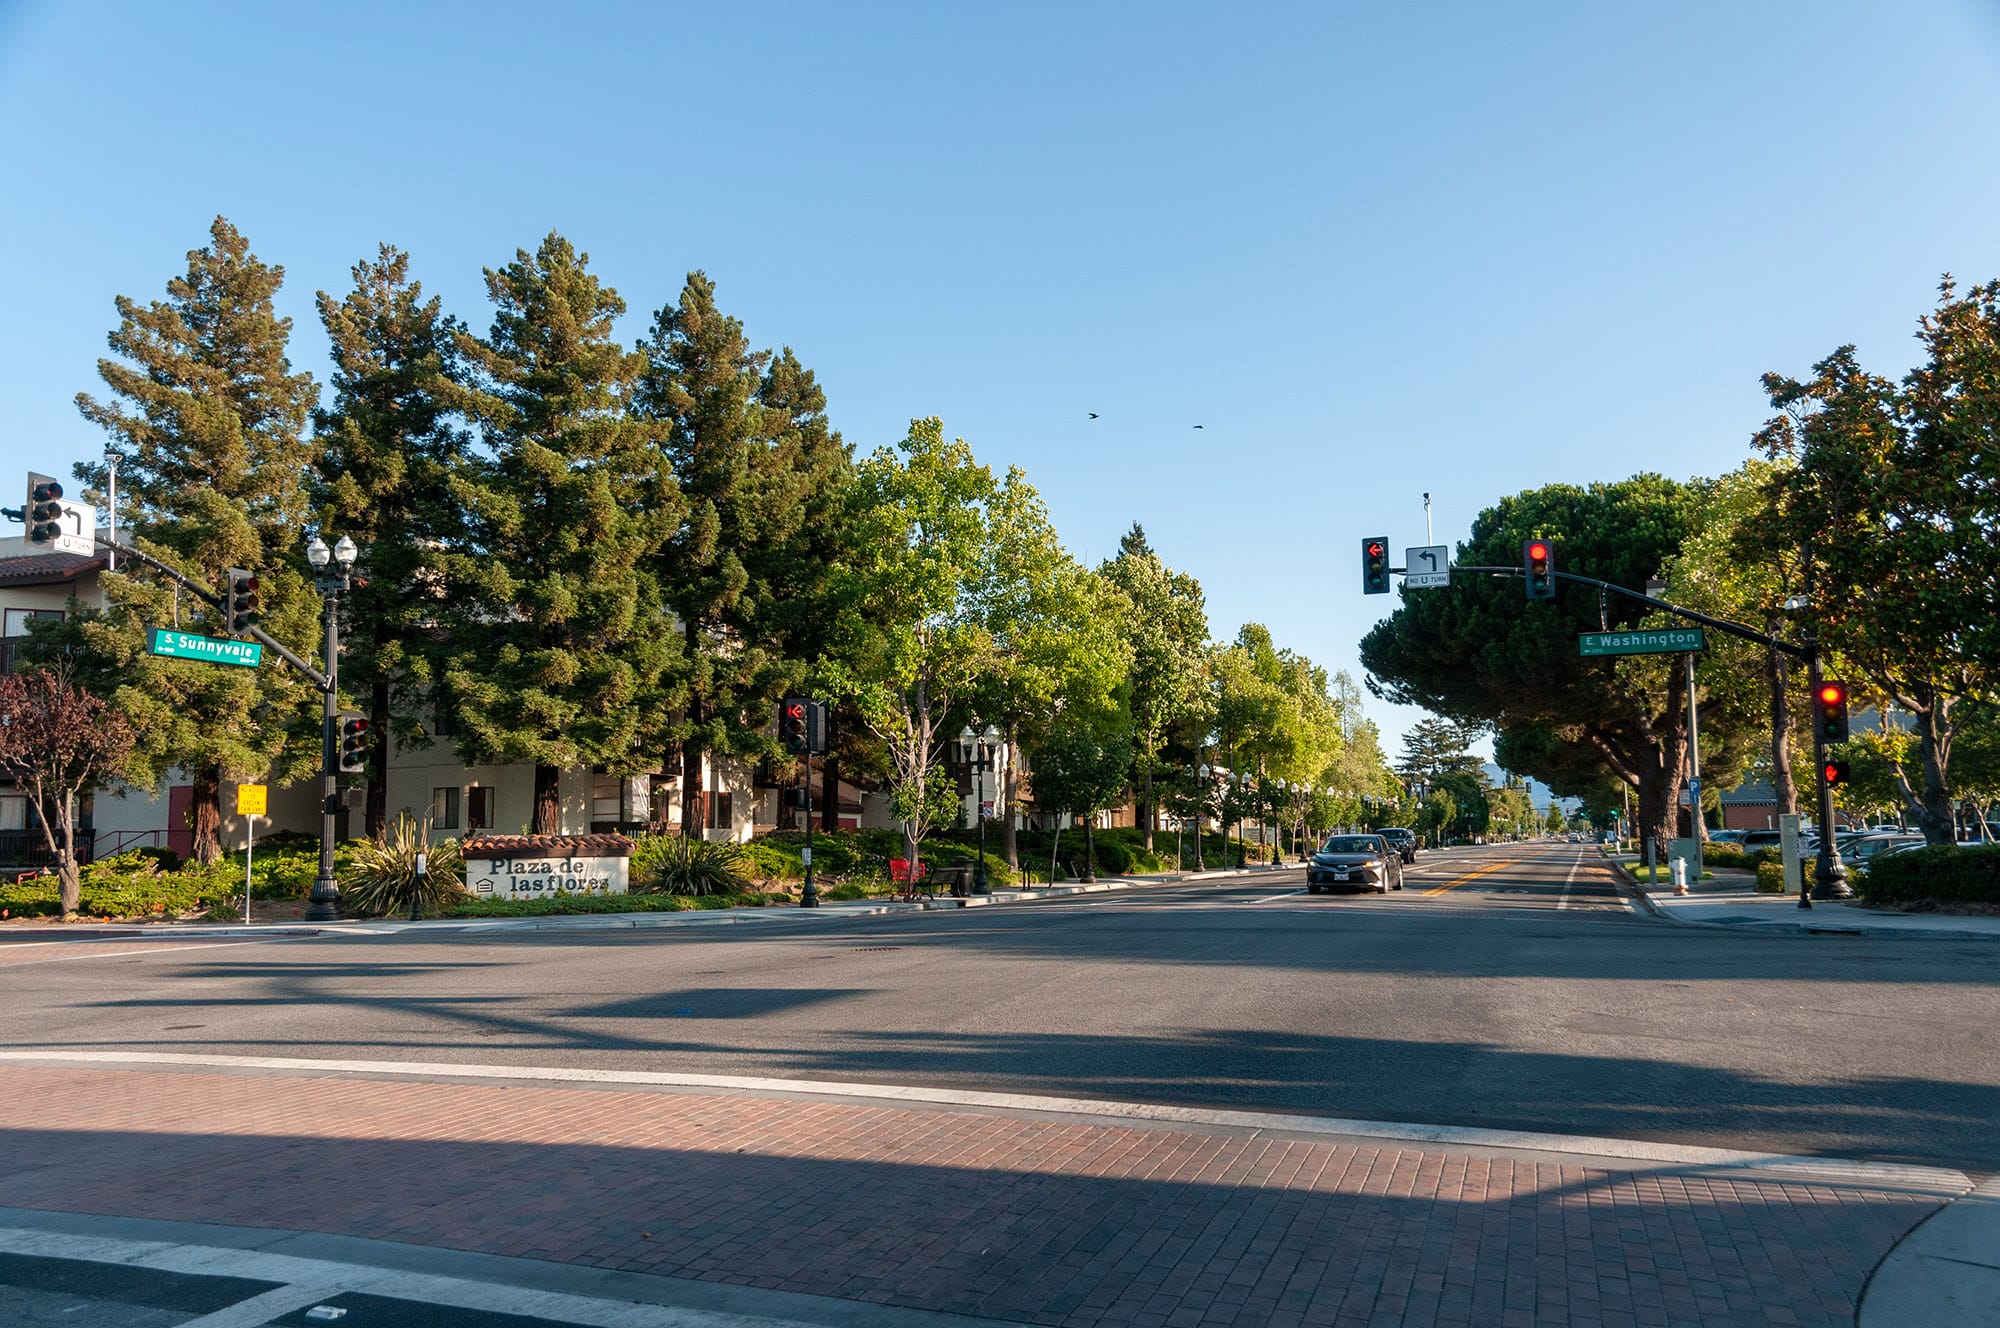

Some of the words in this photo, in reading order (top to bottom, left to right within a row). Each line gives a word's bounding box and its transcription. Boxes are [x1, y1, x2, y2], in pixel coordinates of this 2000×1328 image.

[1421, 576, 1428, 584] U
[1431, 575, 1446, 583] TURN
[178, 635, 253, 657] Sunnyvale
[1600, 633, 1695, 648] Washington
[489, 858, 553, 875] Plaza
[560, 857, 584, 874] de
